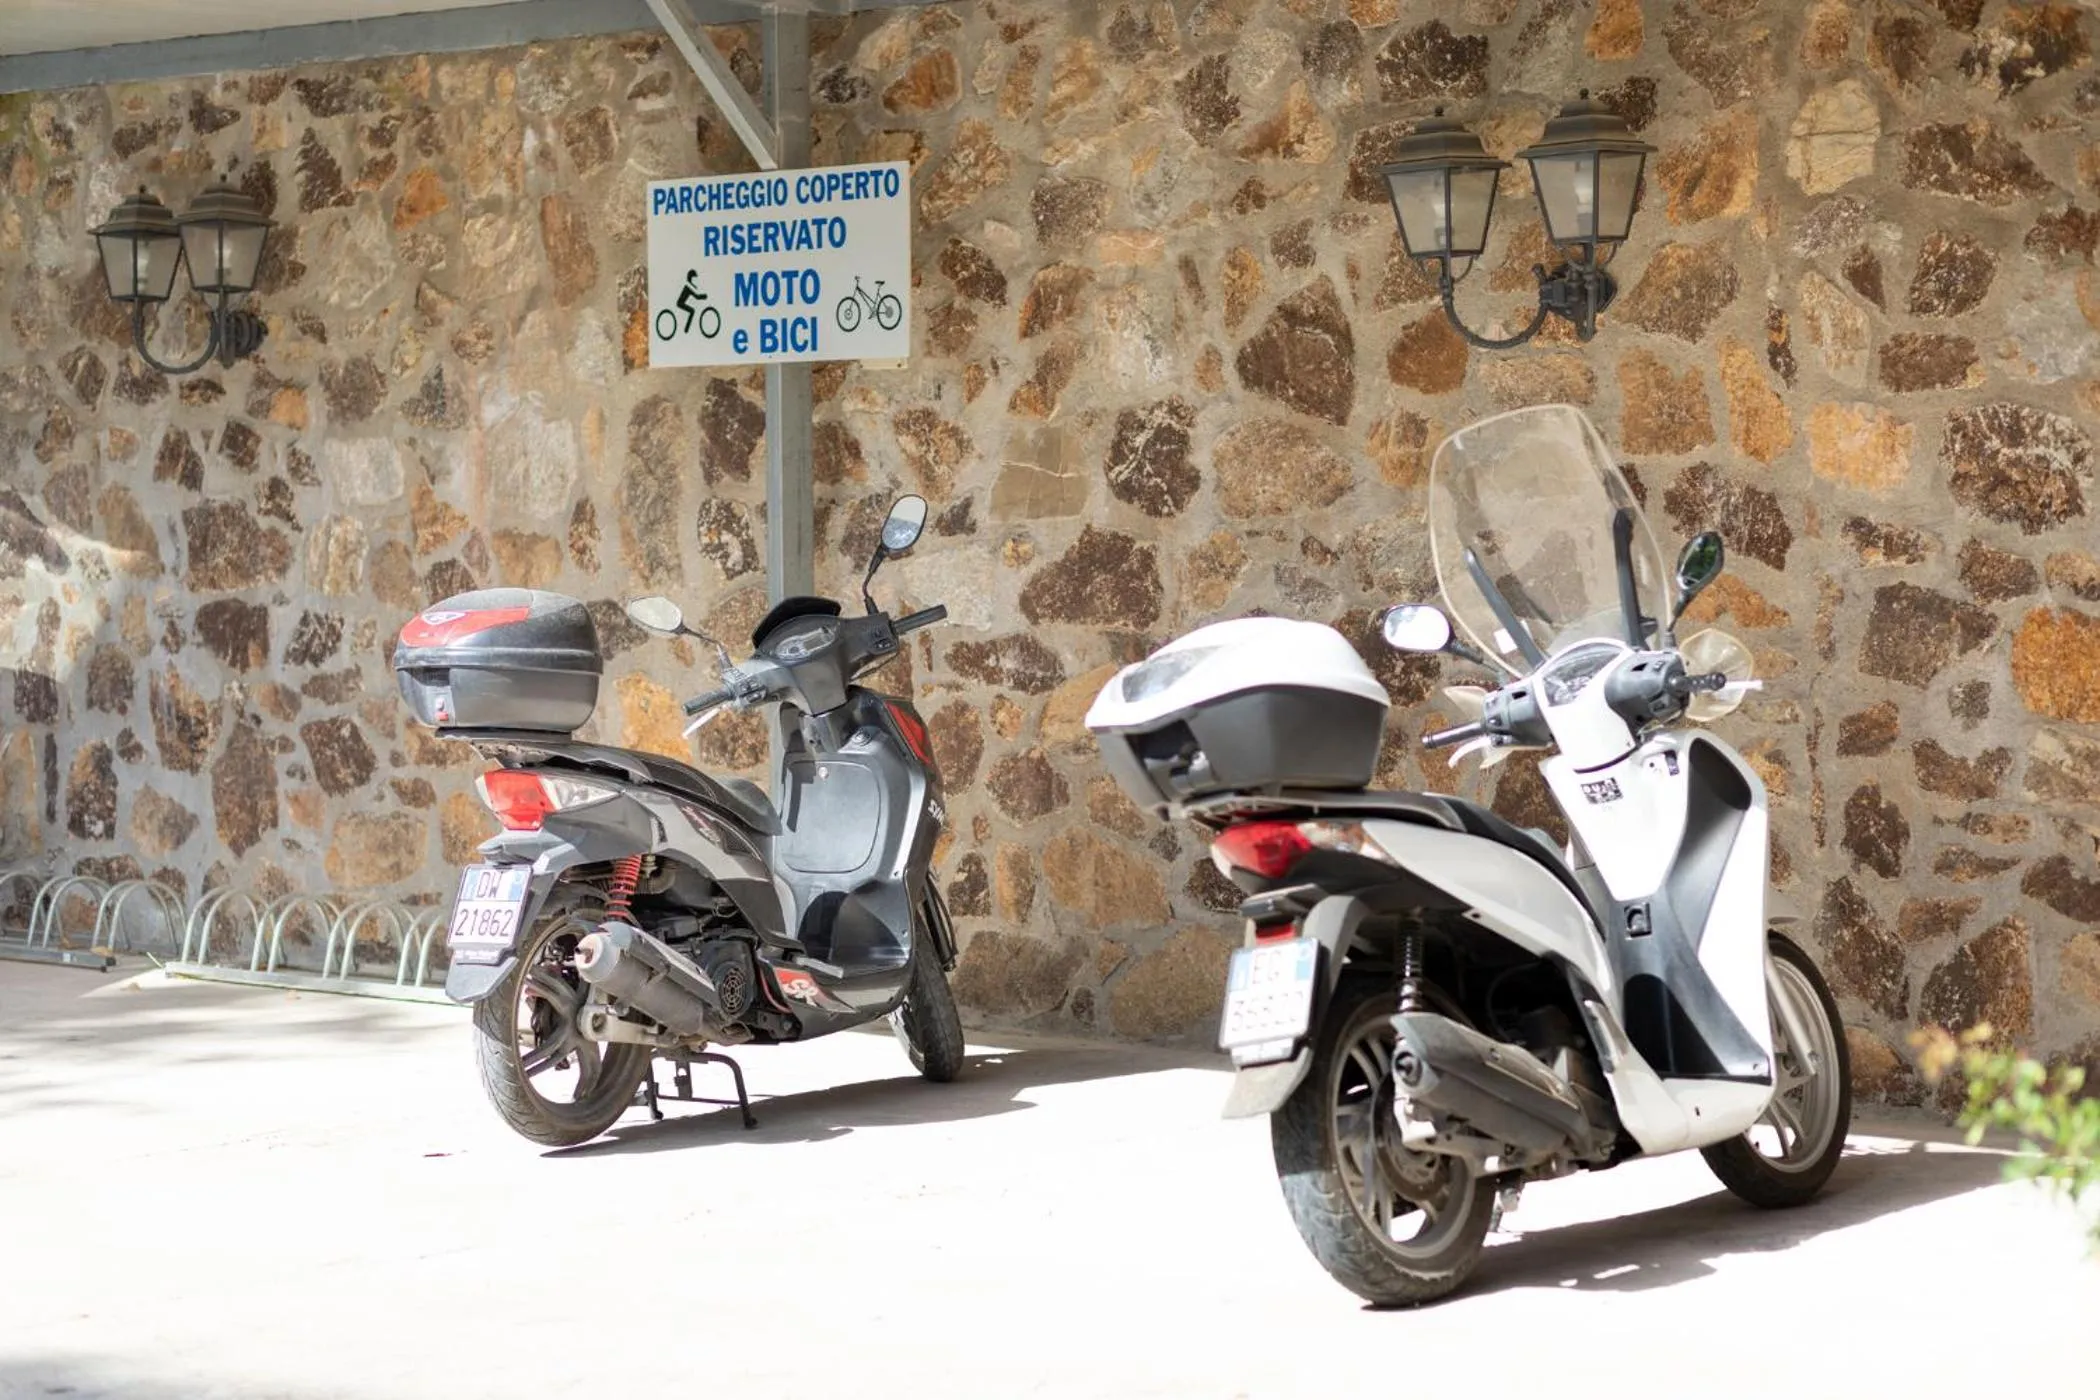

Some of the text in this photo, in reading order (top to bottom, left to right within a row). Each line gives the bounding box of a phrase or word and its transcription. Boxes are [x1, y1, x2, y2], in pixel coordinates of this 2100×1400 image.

[653, 168, 900, 215] PARCHEGGIO COPERTO
[704, 216, 847, 257] RISERVATO
[734, 268, 821, 307] MOTO
[733, 316, 818, 354] e BICI
[455, 908, 514, 937] 21862
